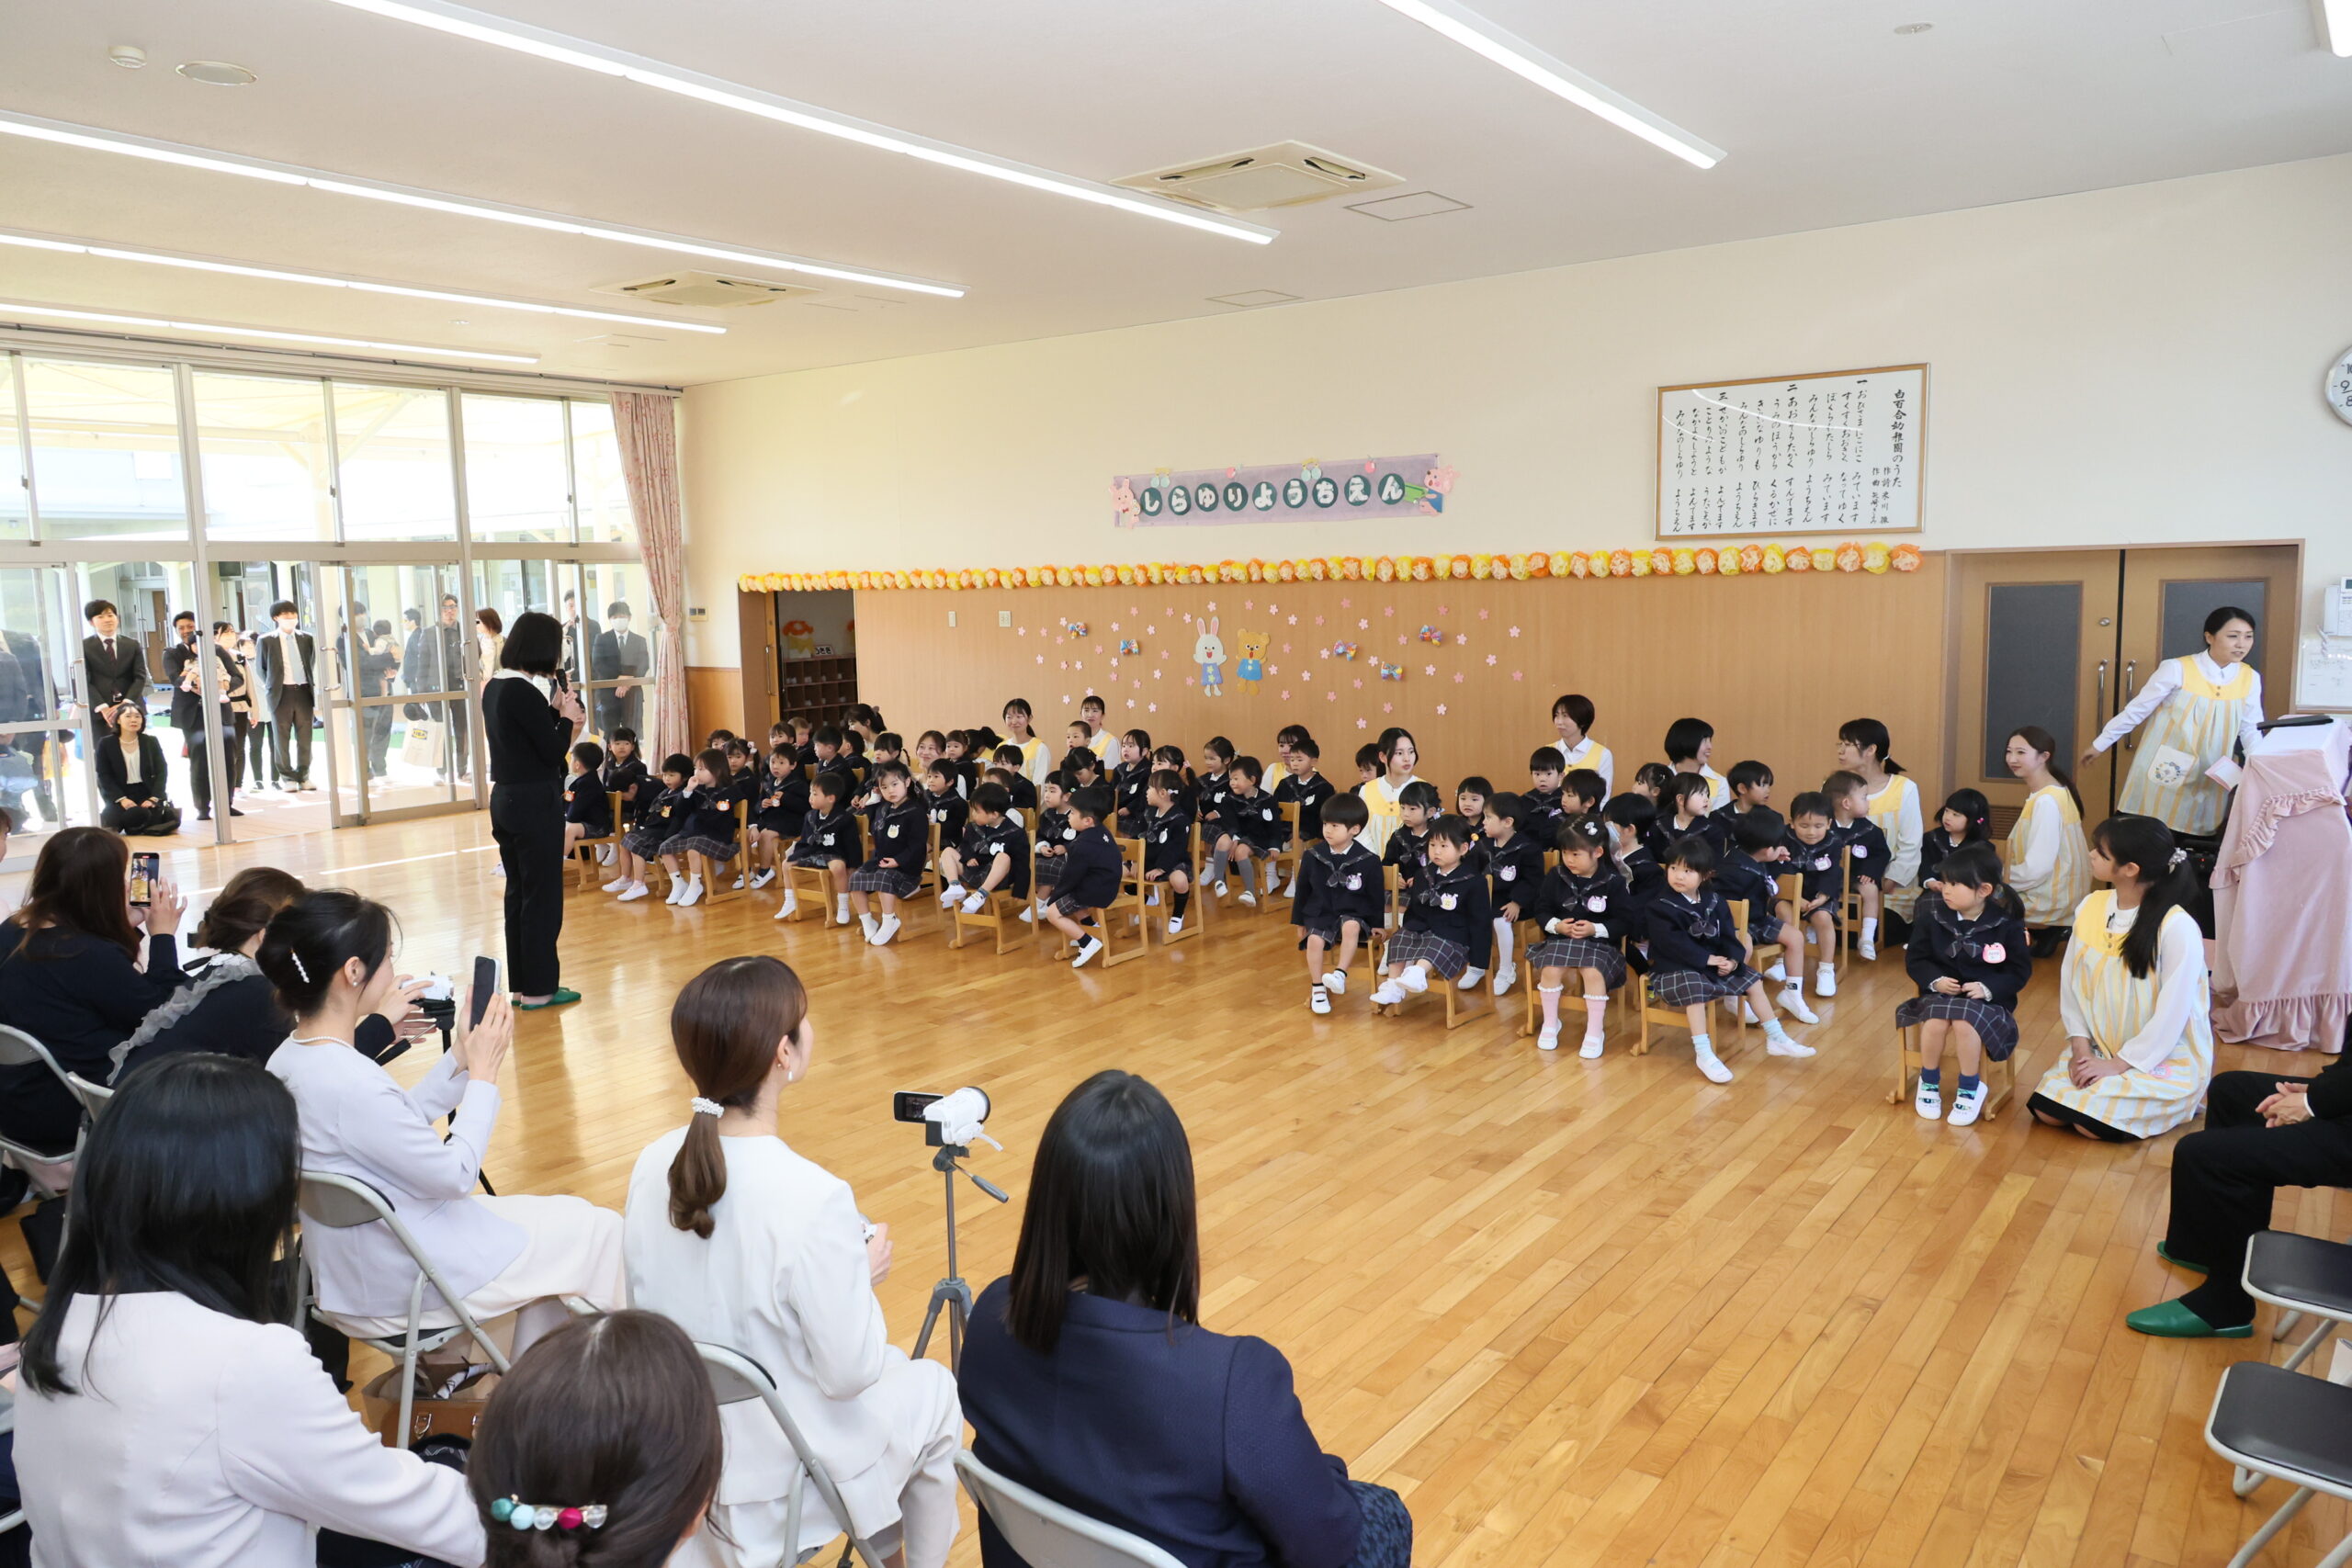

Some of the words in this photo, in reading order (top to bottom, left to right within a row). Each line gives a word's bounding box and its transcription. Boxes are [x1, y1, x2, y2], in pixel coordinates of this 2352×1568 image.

[2340, 379, 2350, 391] 9
[1890, 389, 1907, 488] 白百合幼稚園のうた
[1144, 475, 1403, 513] しらゆりようちえん
[1672, 489, 1681, 533] ようちえん
[1733, 481, 1743, 528] ようちえん
[1802, 474, 1813, 523] ようちえん
[1820, 473, 1833, 523] みています
[1850, 471, 1861, 523] みています
